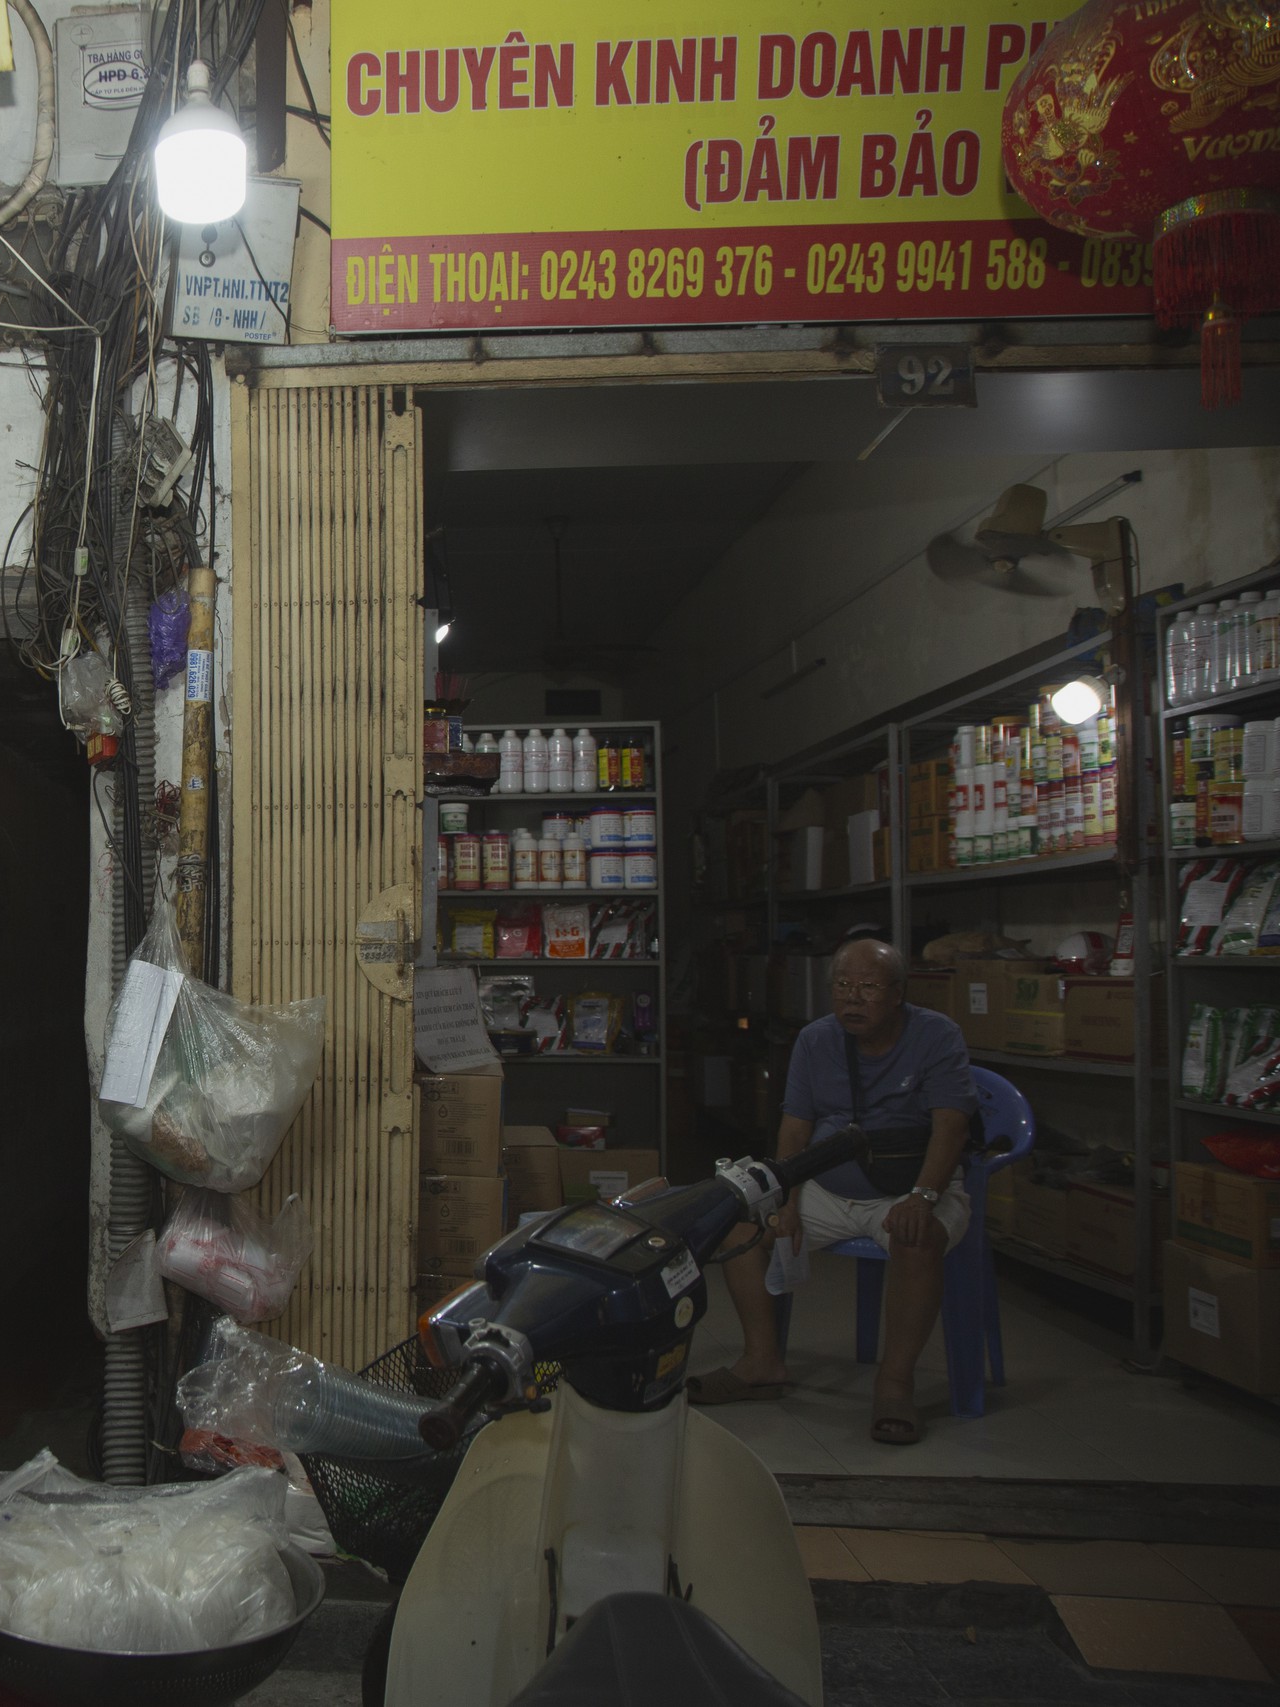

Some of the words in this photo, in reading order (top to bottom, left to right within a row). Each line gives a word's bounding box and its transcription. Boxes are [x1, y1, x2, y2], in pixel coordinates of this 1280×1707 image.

[346, 30, 575, 117] CHUYÊN
[594, 36, 738, 106] KINH
[757, 25, 966, 101] DOANH
[859, 108, 982, 199] BẢO
[345, 244, 419, 316] ĐIỆN
[429, 250, 530, 313] THOẠI:
[539, 248, 617, 301] 0243
[627, 247, 706, 300] 8269
[714, 244, 774, 297] 376
[806, 242, 887, 295] 0243
[897, 240, 973, 293] 9941
[986, 237, 1048, 291] 588
[896, 353, 956, 396] 92
